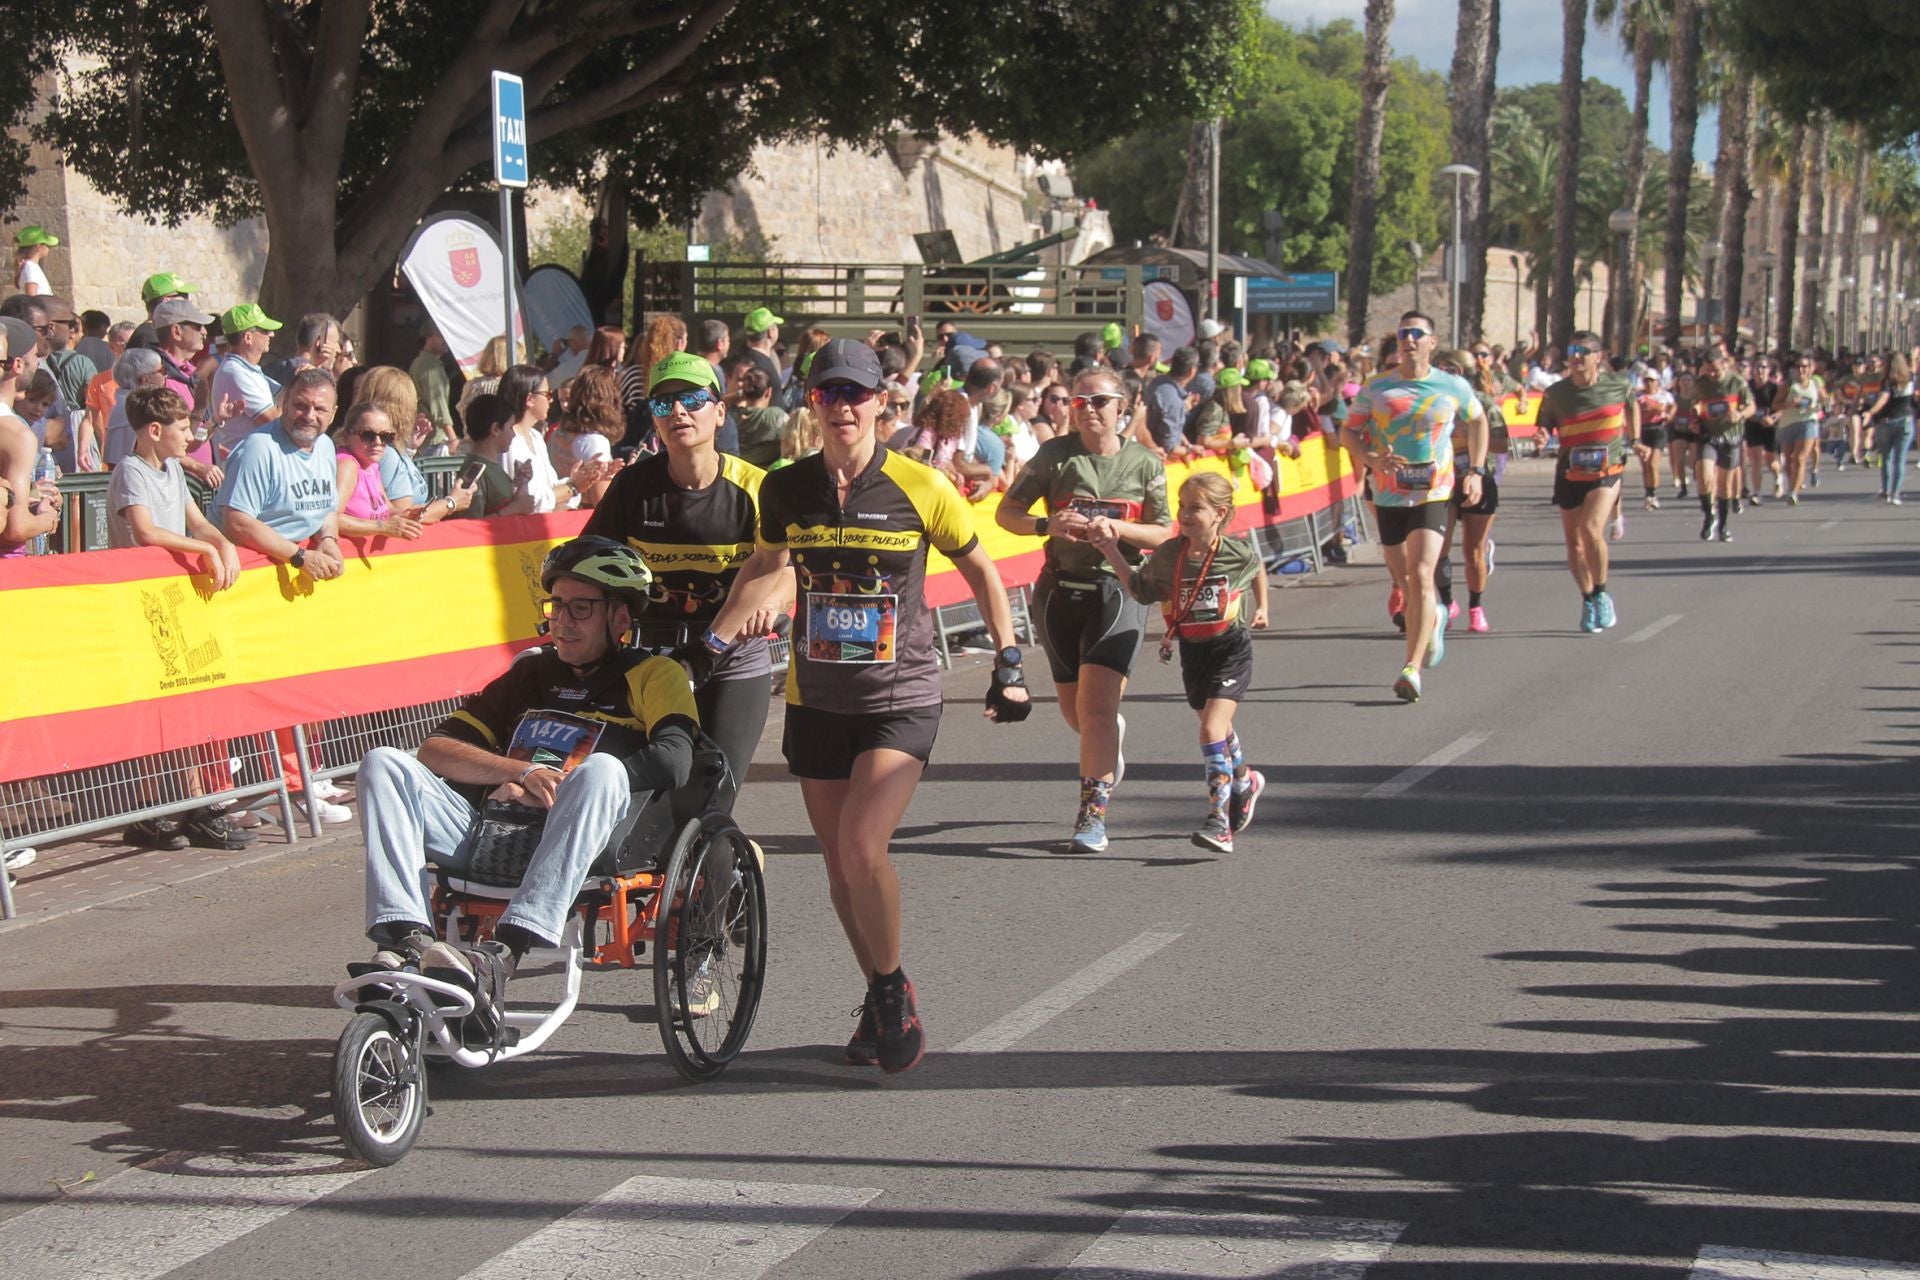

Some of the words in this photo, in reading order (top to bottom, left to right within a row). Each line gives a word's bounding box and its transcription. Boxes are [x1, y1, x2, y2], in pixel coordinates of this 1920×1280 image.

[500, 115, 525, 146] TAXI
[290, 478, 332, 500] UCAM
[871, 534, 911, 547] RUEDAS
[826, 607, 868, 631] 699
[529, 720, 580, 742] 1477
